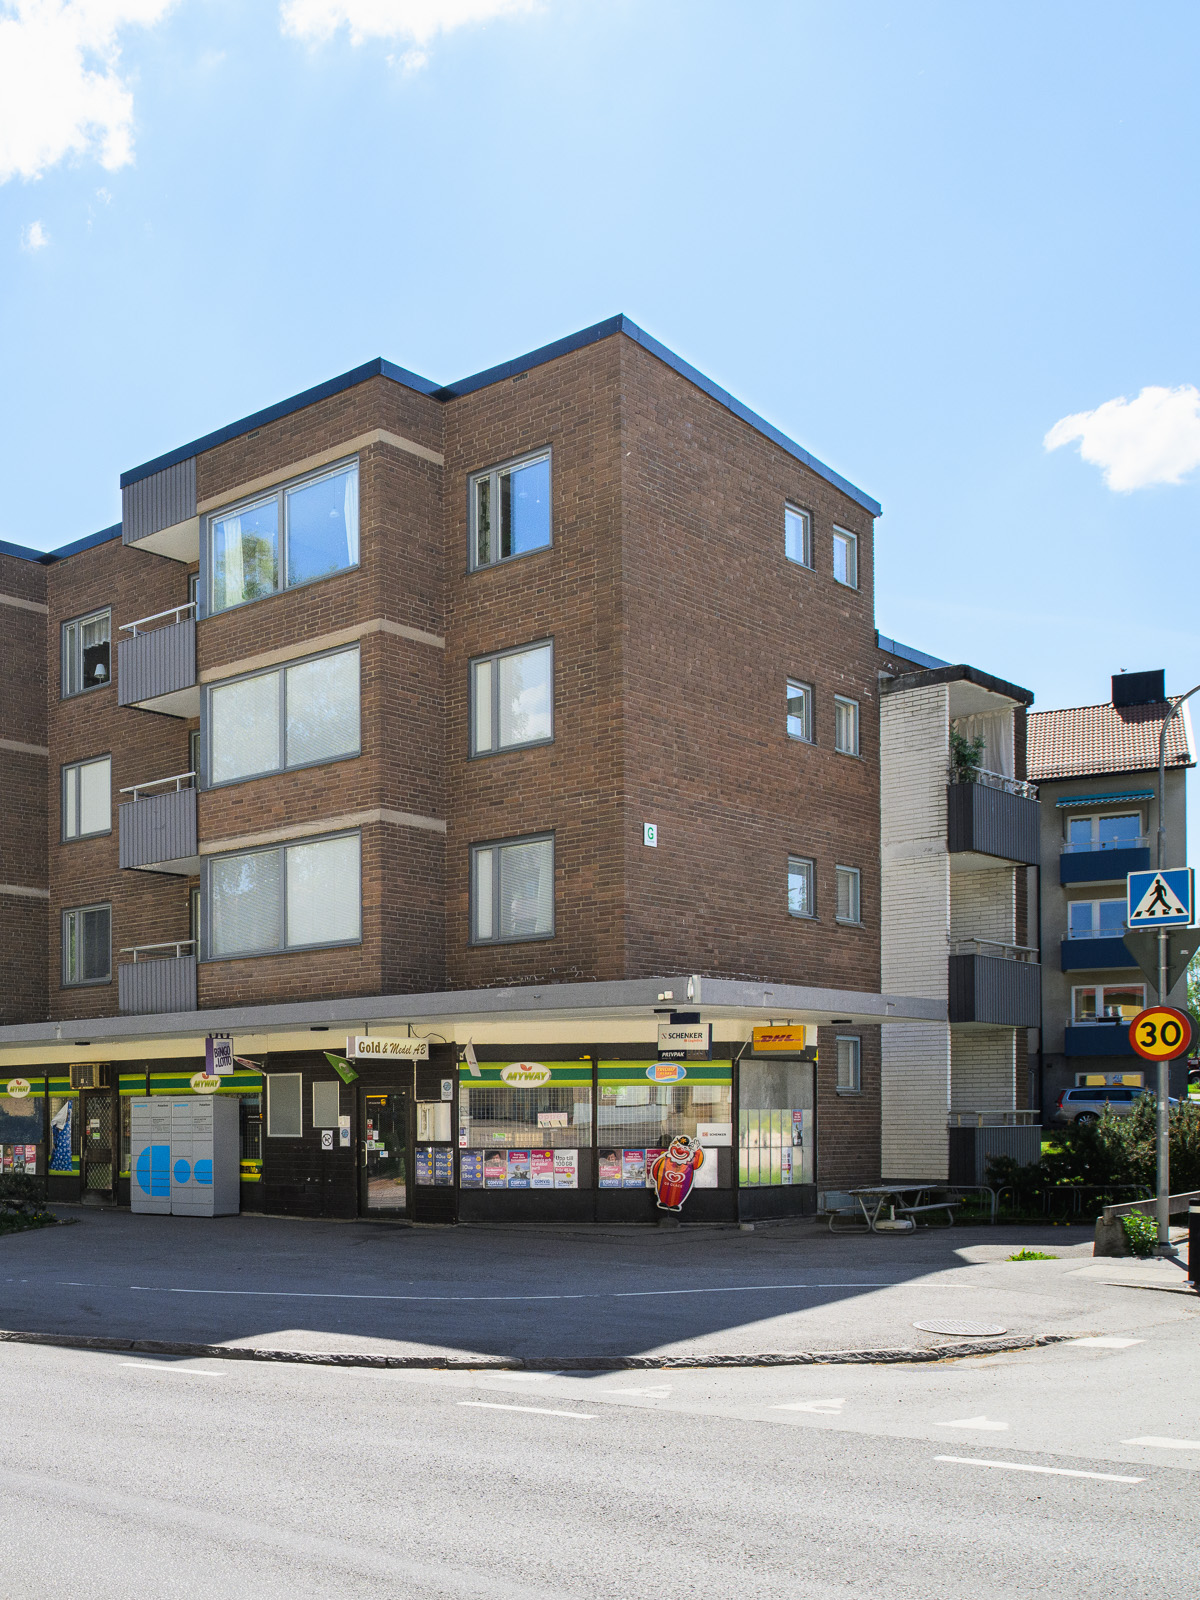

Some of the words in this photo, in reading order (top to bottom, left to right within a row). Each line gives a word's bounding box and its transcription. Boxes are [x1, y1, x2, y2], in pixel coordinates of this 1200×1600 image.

[647, 826, 654, 840] G
[760, 1034, 796, 1042] DHL
[1140, 1020, 1182, 1048] 30
[358, 1041, 381, 1054] Gold
[382, 1042, 388, 1054] &
[413, 1043, 427, 1055] AB
[217, 1056, 232, 1067] LOTTO
[506, 1072, 548, 1080] MYWAY
[193, 1079, 220, 1088] MYWAY
